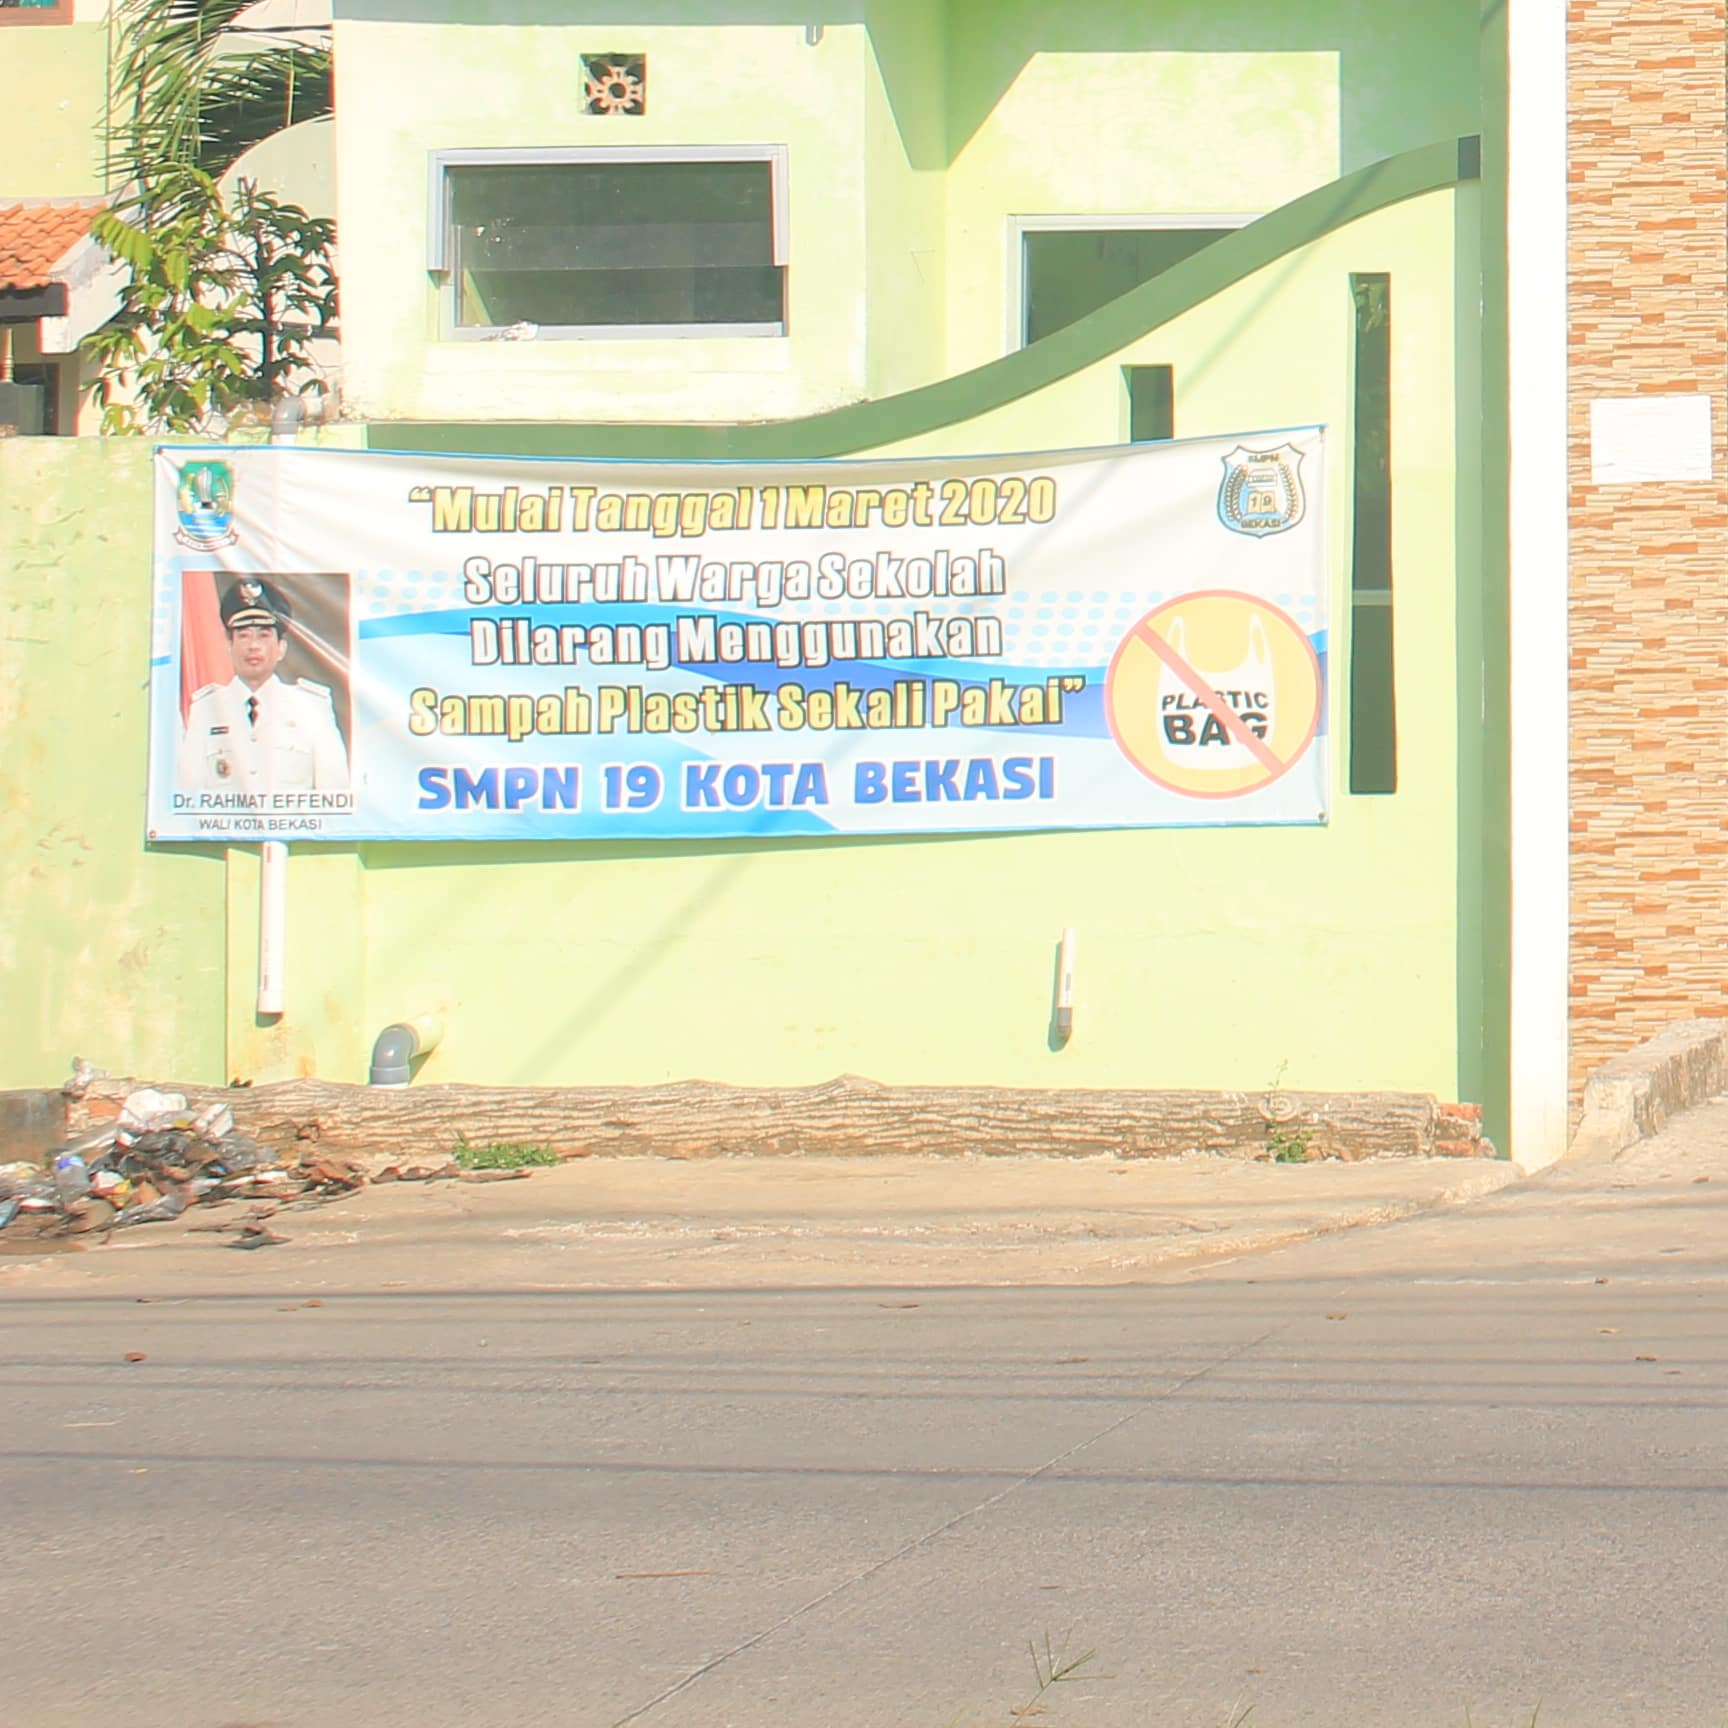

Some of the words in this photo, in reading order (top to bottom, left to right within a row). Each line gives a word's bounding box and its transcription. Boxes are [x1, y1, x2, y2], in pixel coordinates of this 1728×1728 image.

[407, 485, 565, 534] “Mulai
[569, 485, 754, 539] Tanggal
[760, 485, 781, 530] 1
[784, 480, 934, 531] Maret
[938, 475, 1058, 528] 2020
[463, 555, 650, 605] Seluruh
[655, 553, 813, 608] Warga
[816, 547, 1007, 600] Sekolah
[469, 616, 673, 672] Dilarang
[675, 610, 1004, 670] Menggunakan
[408, 685, 593, 743] Sampah
[597, 683, 773, 735] Plastik
[776, 679, 928, 732] Sekali
[931, 674, 1087, 729] Pakai”
[1162, 711, 1269, 747] BAG
[173, 793, 195, 809] Dr.
[199, 793, 269, 809] RAHMAT
[272, 792, 355, 809] EFFENDI
[417, 765, 580, 811] SMPN
[603, 763, 661, 810] 19
[684, 760, 830, 809] KOTA
[853, 756, 1056, 805] BEKASI
[234, 818, 266, 831] KOTA
[267, 817, 323, 831] BEKASI
